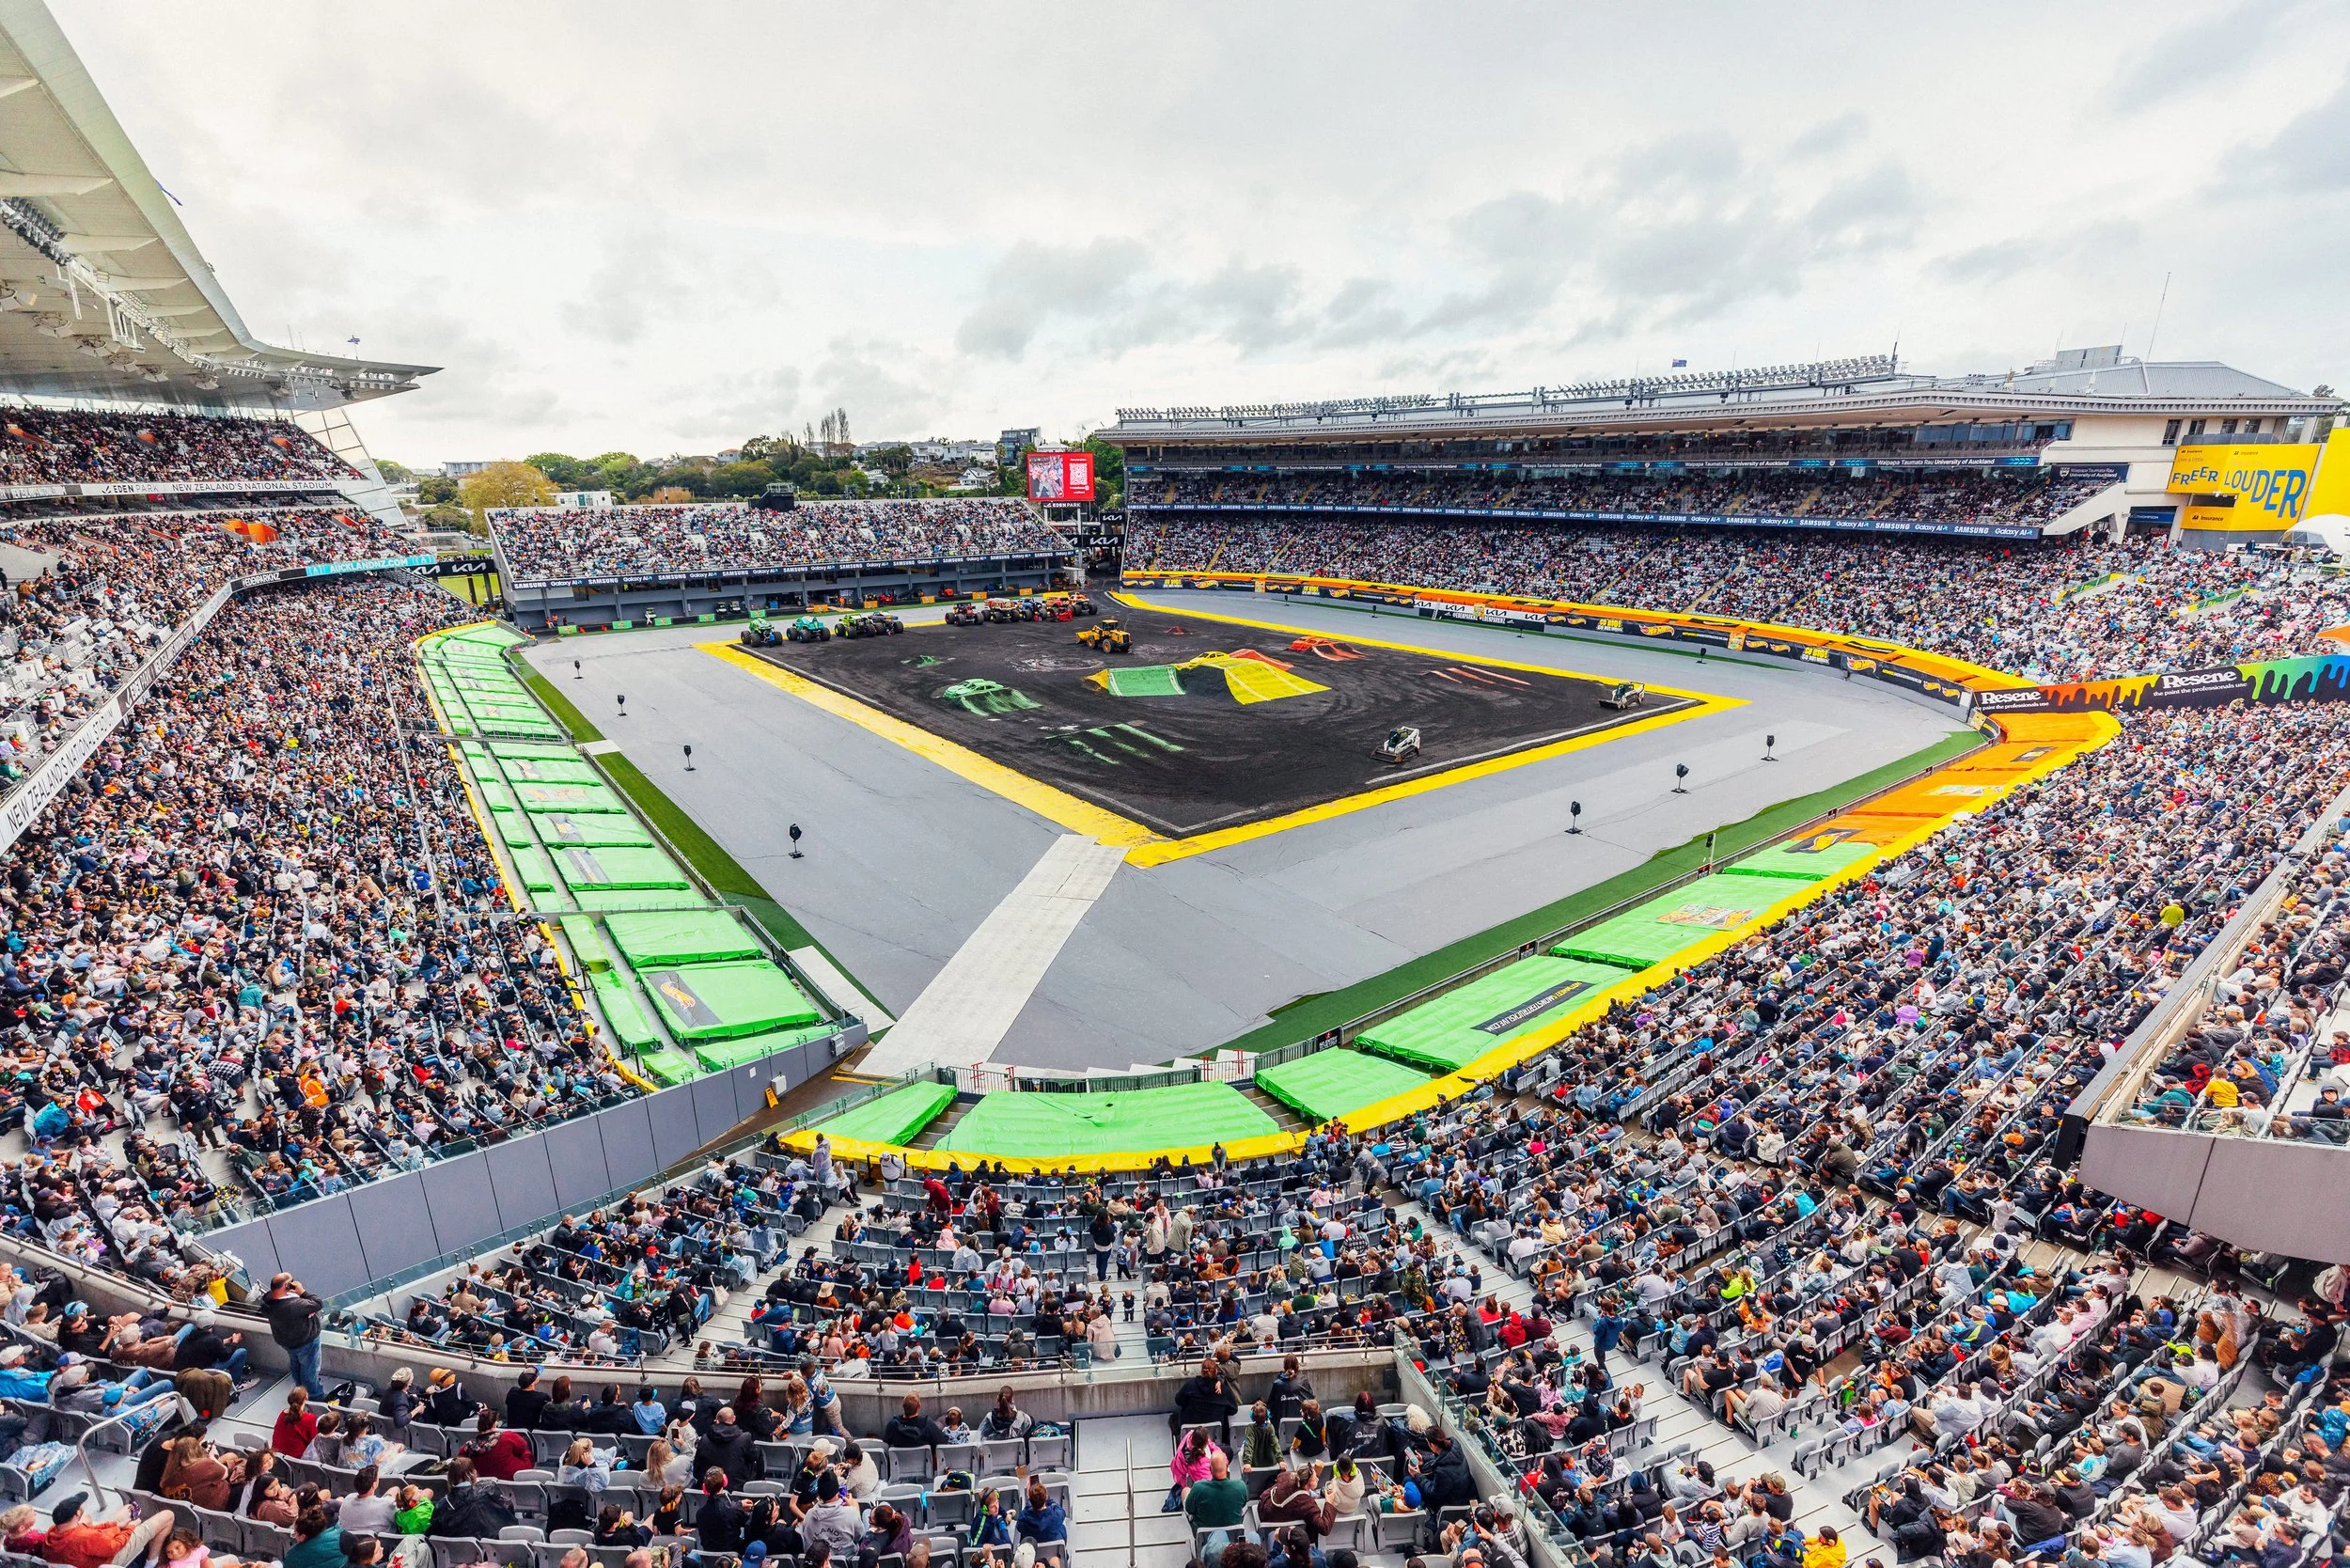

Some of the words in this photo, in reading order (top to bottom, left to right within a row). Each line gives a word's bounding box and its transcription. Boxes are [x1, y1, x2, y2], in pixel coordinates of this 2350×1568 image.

[2172, 467, 2219, 485] FREER
[2224, 470, 2306, 518] LOUDER
[1995, 528, 2019, 536] Galaxy
[330, 559, 408, 572] AUCKLANDNZ.COM
[452, 563, 486, 572] KIA
[2163, 670, 2237, 689] Resene
[2192, 684, 2234, 694] professionals
[1982, 691, 2041, 705] Resene
[7, 802, 30, 834] NEW
[28, 762, 69, 811] ZEALAND'S
[67, 733, 96, 772] NATIONAL
[94, 708, 114, 741] STADIUM
[797, 1269, 807, 1278] 34
